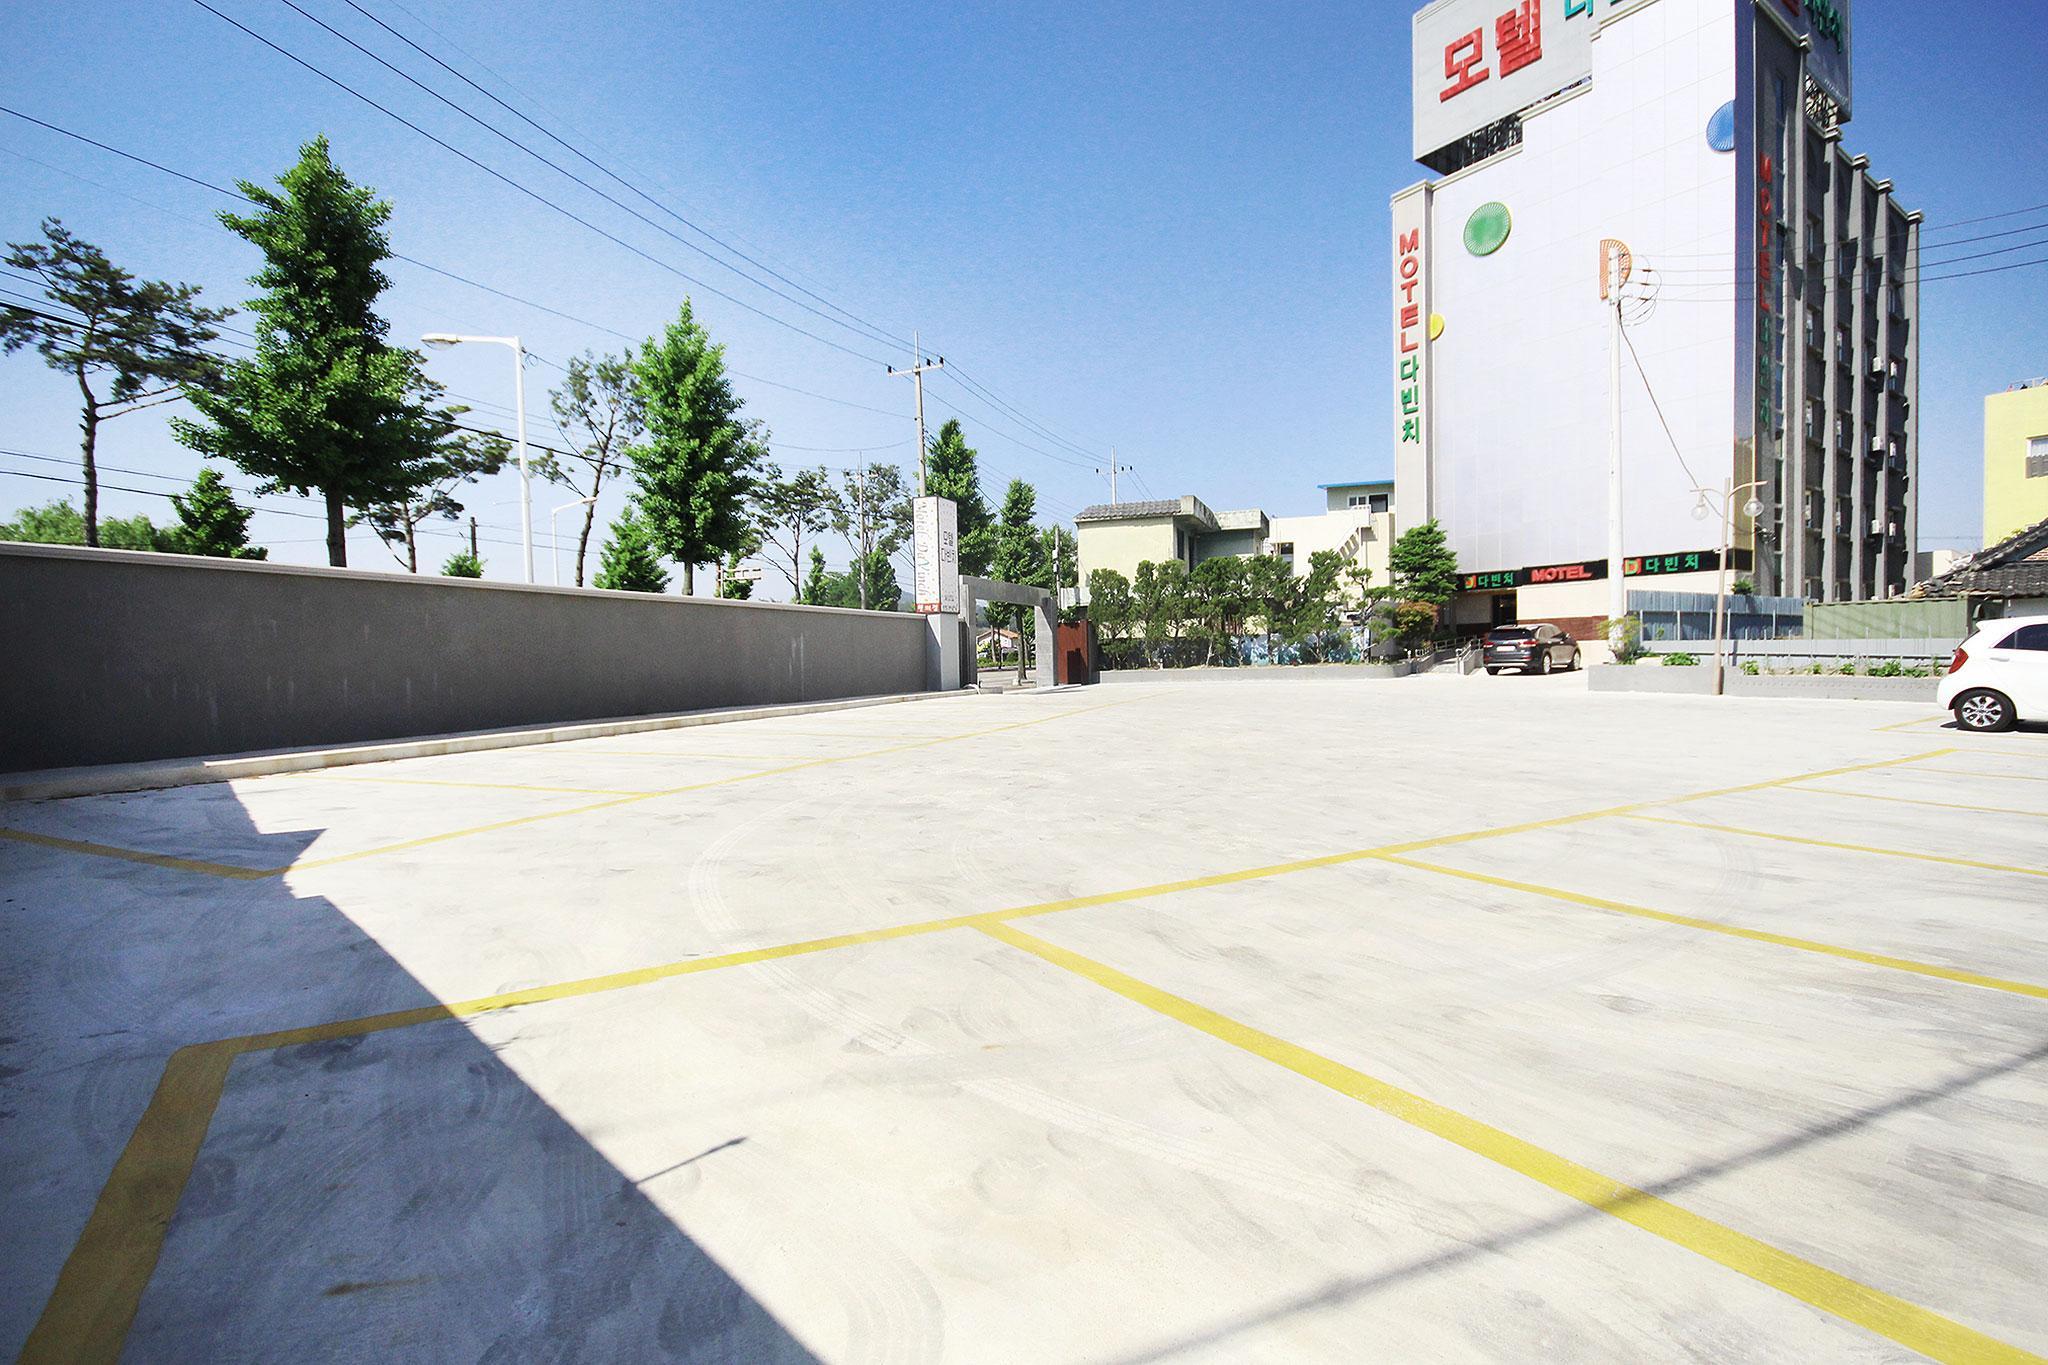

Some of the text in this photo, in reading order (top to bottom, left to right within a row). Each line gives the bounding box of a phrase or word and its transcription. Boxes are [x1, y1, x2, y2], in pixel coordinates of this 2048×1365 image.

[1439, 0, 1542, 103] 모텔
[1759, 152, 1771, 312] MOTEL
[1399, 228, 1419, 353] MOTEL
[1400, 354, 1419, 444] 다빈치
[1478, 572, 1514, 588] 다빈치
[1531, 565, 1593, 583] MOTEL
[1645, 554, 1699, 573] 다빈치
